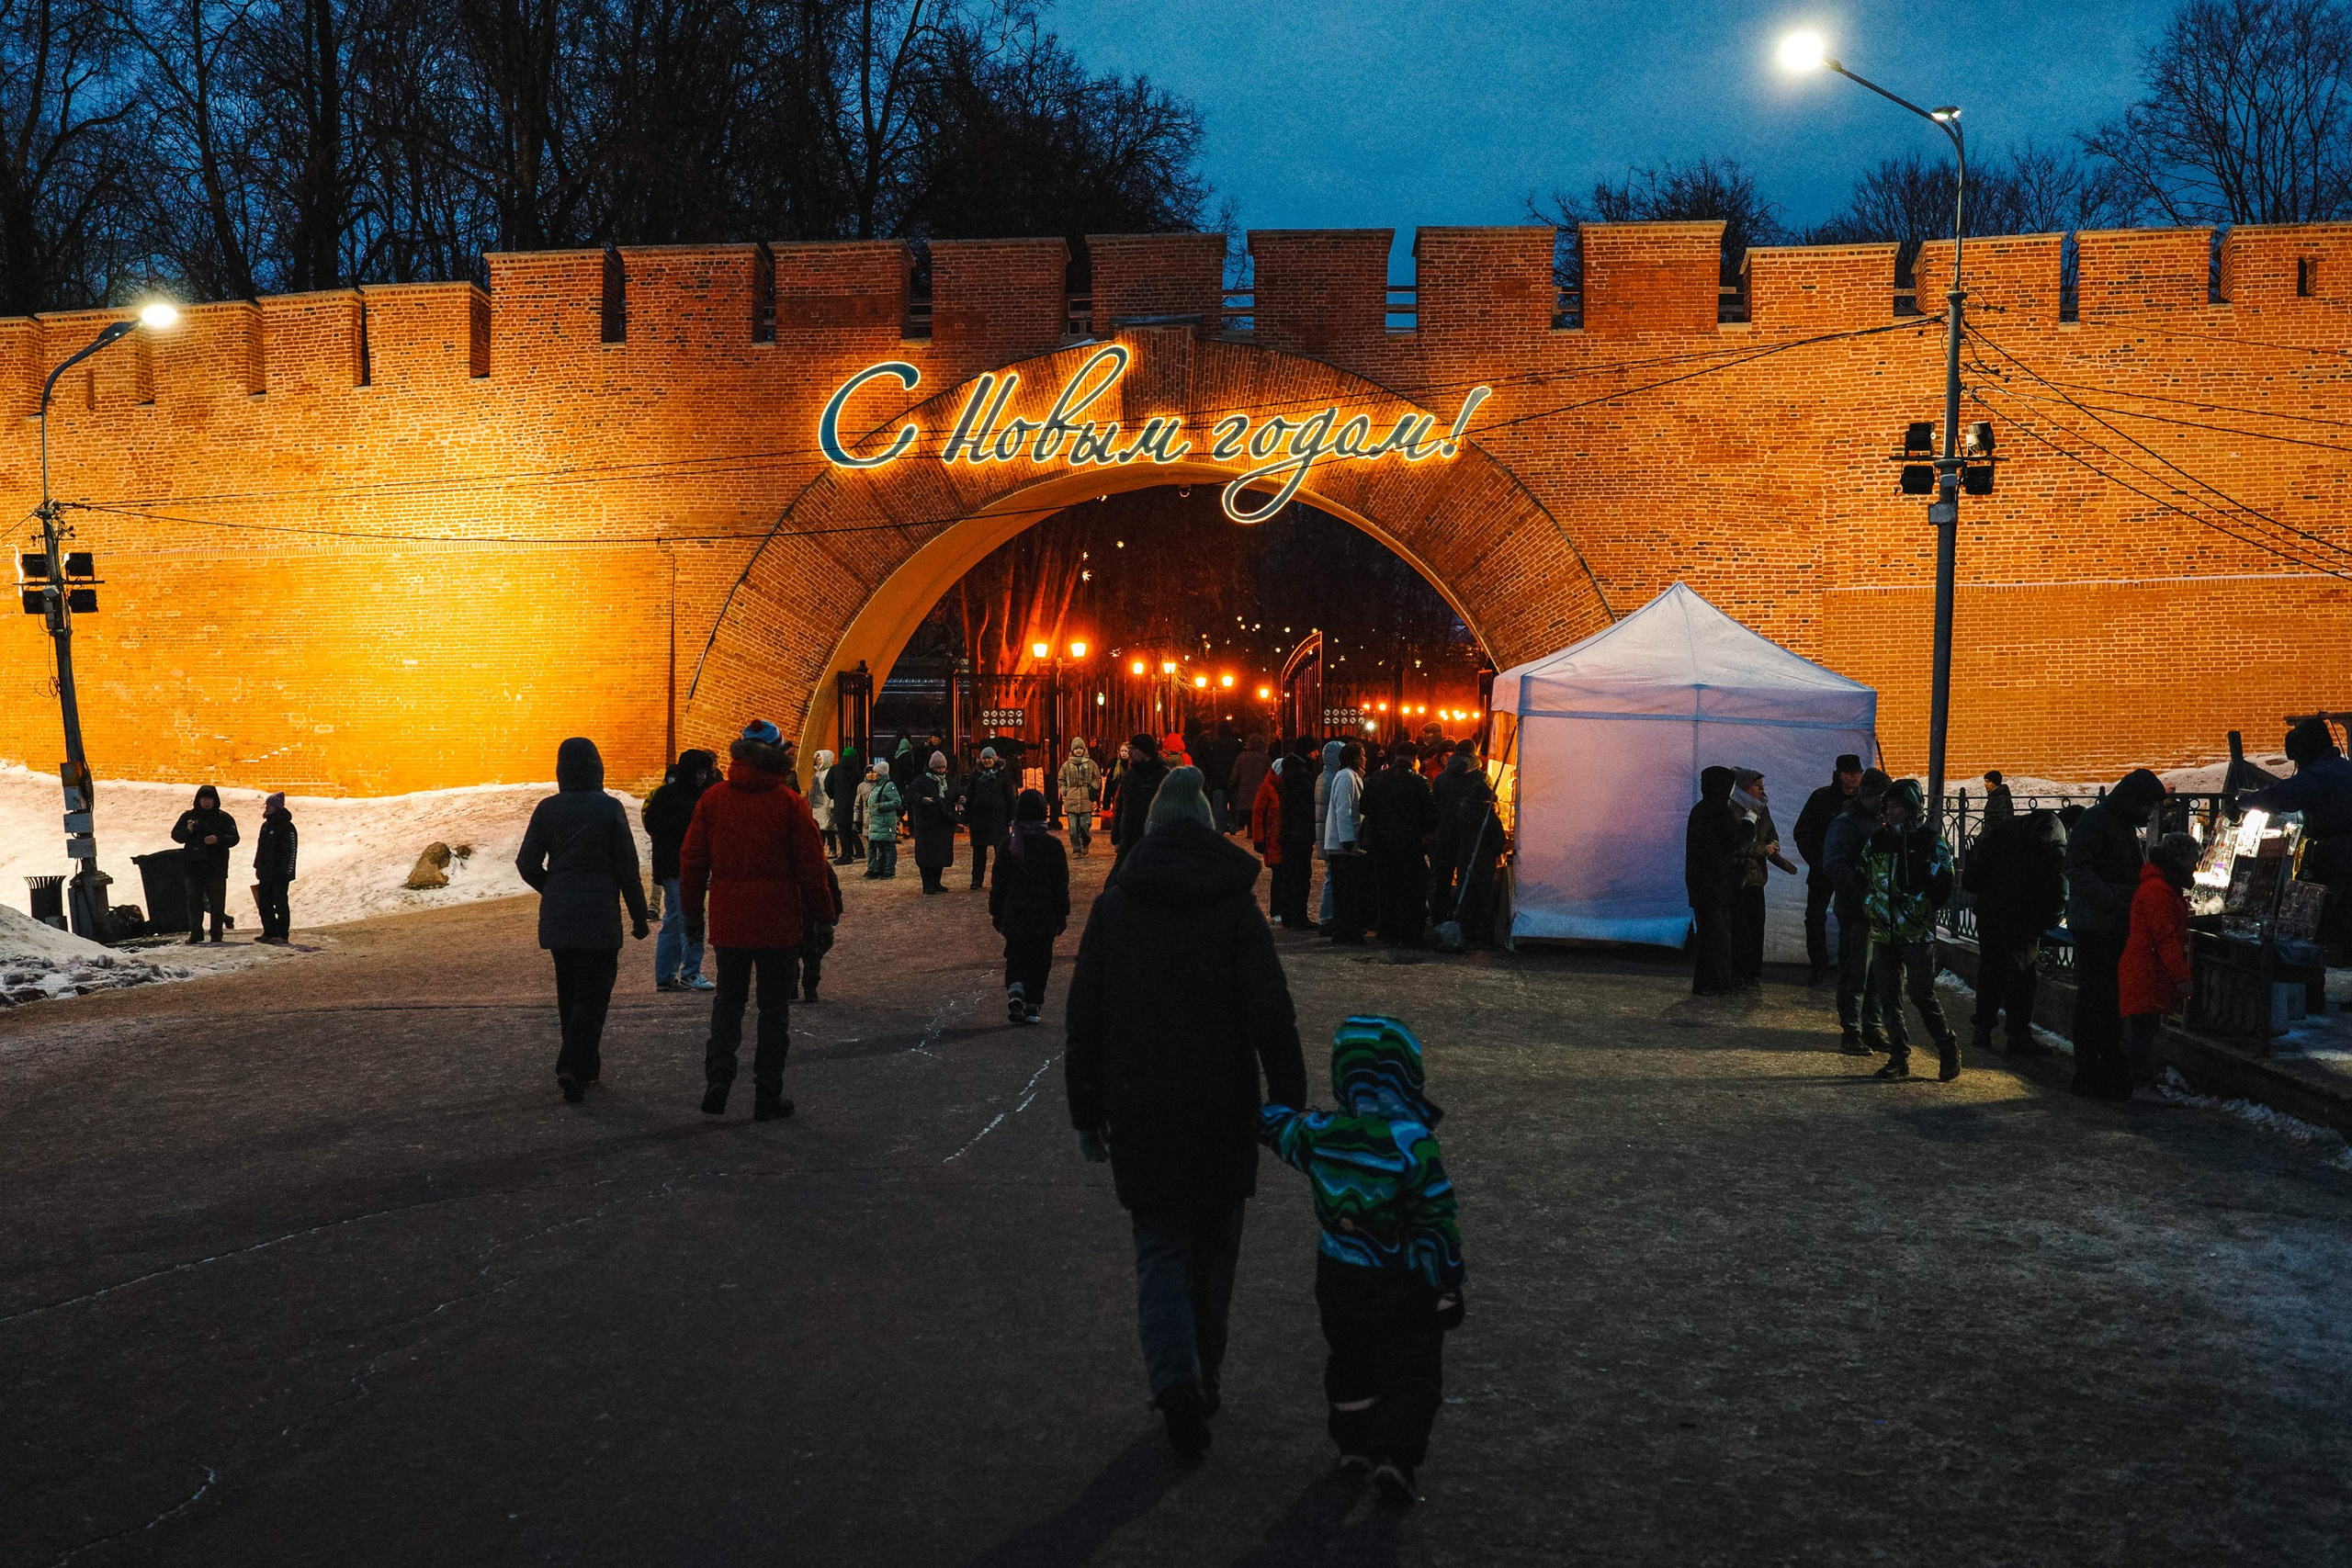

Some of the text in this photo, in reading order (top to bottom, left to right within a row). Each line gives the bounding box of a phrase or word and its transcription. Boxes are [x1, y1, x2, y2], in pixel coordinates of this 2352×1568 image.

[818, 344, 1492, 524] С Новым годом!
